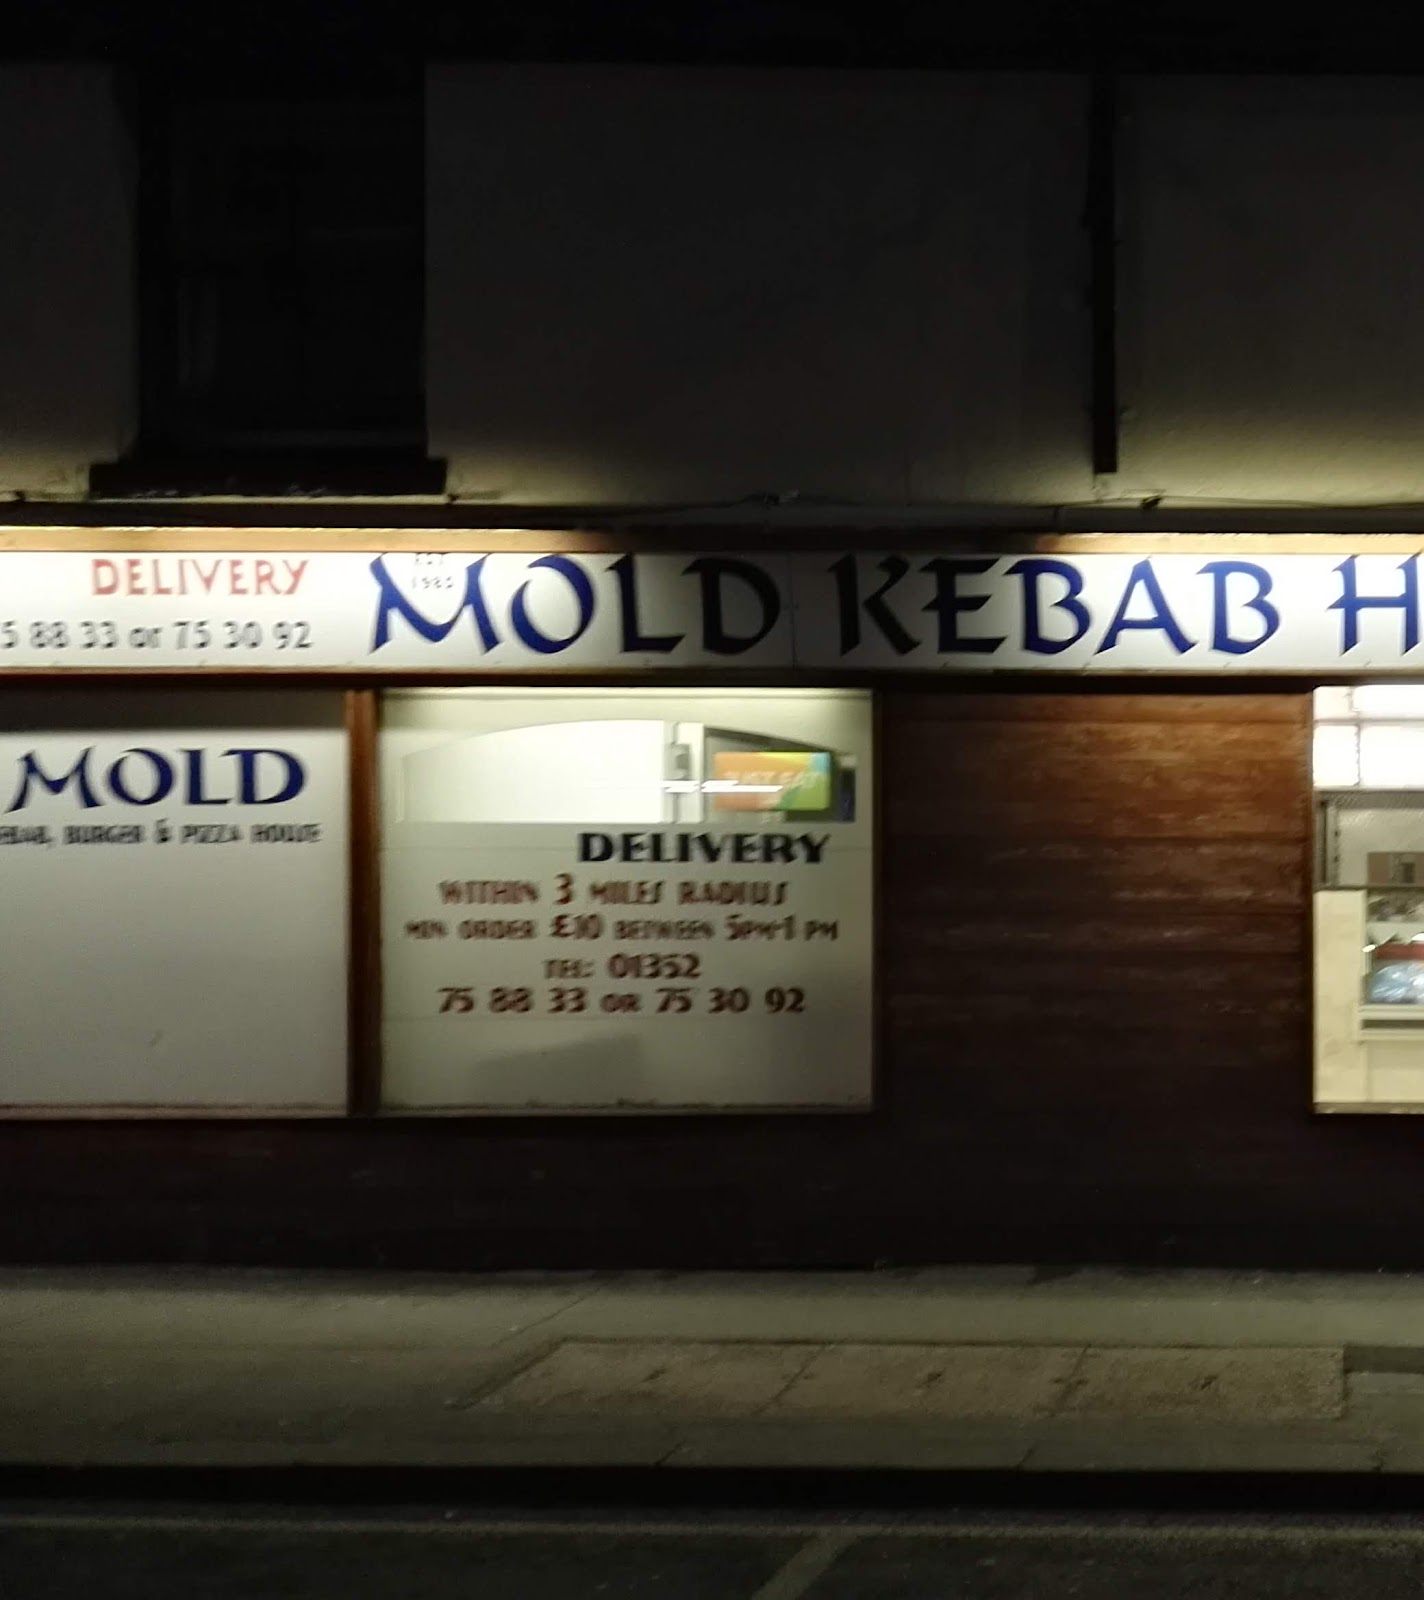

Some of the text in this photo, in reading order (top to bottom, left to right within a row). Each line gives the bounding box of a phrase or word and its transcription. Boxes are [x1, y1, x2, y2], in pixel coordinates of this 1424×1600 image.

[91, 558, 309, 596] DELIVERY
[368, 553, 780, 655] MOLD
[827, 553, 1280, 656] KEBAB
[30, 619, 71, 650] 88
[79, 619, 119, 649] 33
[128, 626, 163, 649] or
[172, 619, 212, 649] 75
[222, 619, 264, 649] 30
[272, 619, 314, 650] 92
[3, 746, 306, 813] MOLD
[63, 825, 145, 845] BURGER
[180, 823, 243, 844] PIZZA
[578, 832, 832, 864] DELIVERY
[438, 872, 788, 906] WITHIN 3 MILES RADIUS
[404, 918, 449, 940] MIN
[456, 918, 537, 940] ORDER
[549, 913, 606, 940] £10
[612, 919, 716, 941] BETWEEN
[607, 952, 702, 980] 01352
[437, 986, 806, 1015] 75 88 33 OR 75 30 92
